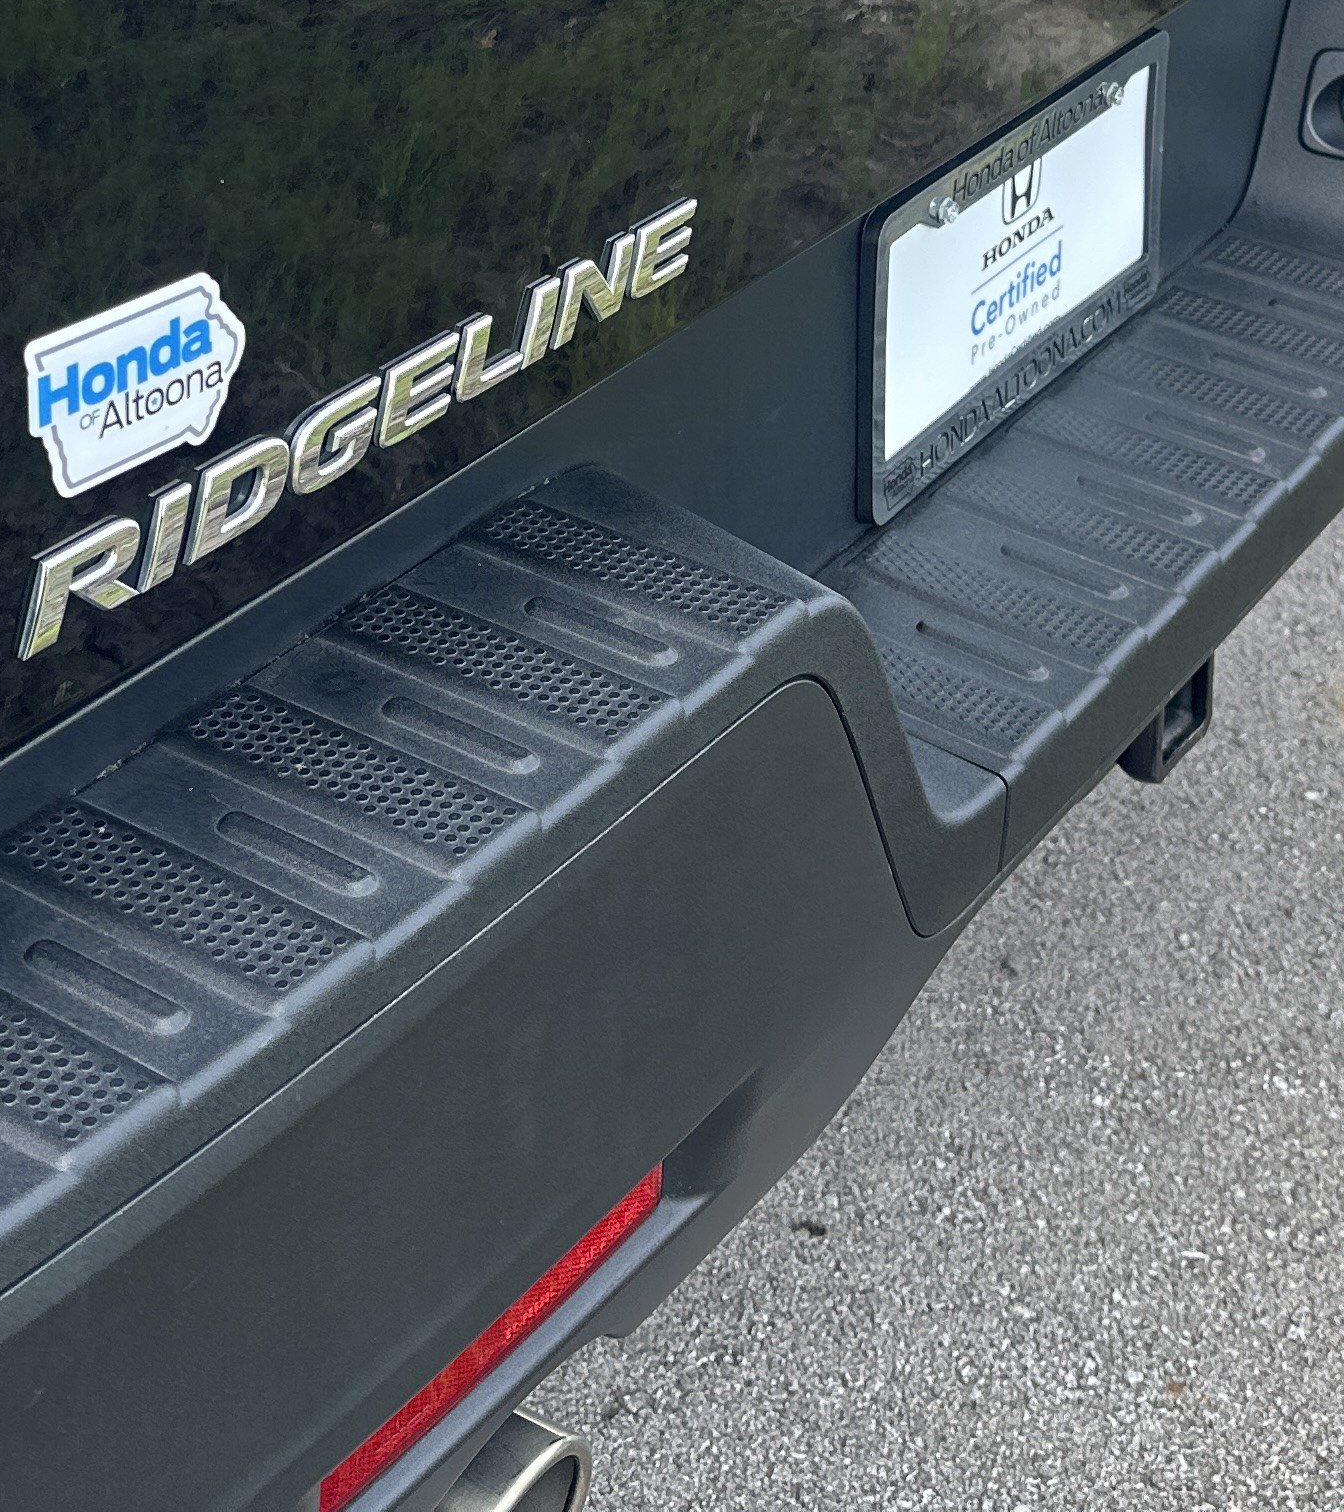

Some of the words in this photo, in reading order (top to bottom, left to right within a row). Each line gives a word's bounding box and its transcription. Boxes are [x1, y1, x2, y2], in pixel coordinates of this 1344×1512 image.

[952, 146, 1015, 202] Honda
[1017, 125, 1040, 162] of
[1038, 85, 1105, 149] Altoona
[970, 239, 1063, 336] Certified
[981, 206, 1055, 272] HONDA
[970, 278, 1062, 366] Pre-Owned
[37, 316, 213, 429] Honda
[98, 360, 224, 439] Altoona
[16, 196, 698, 661] RIDGELINE
